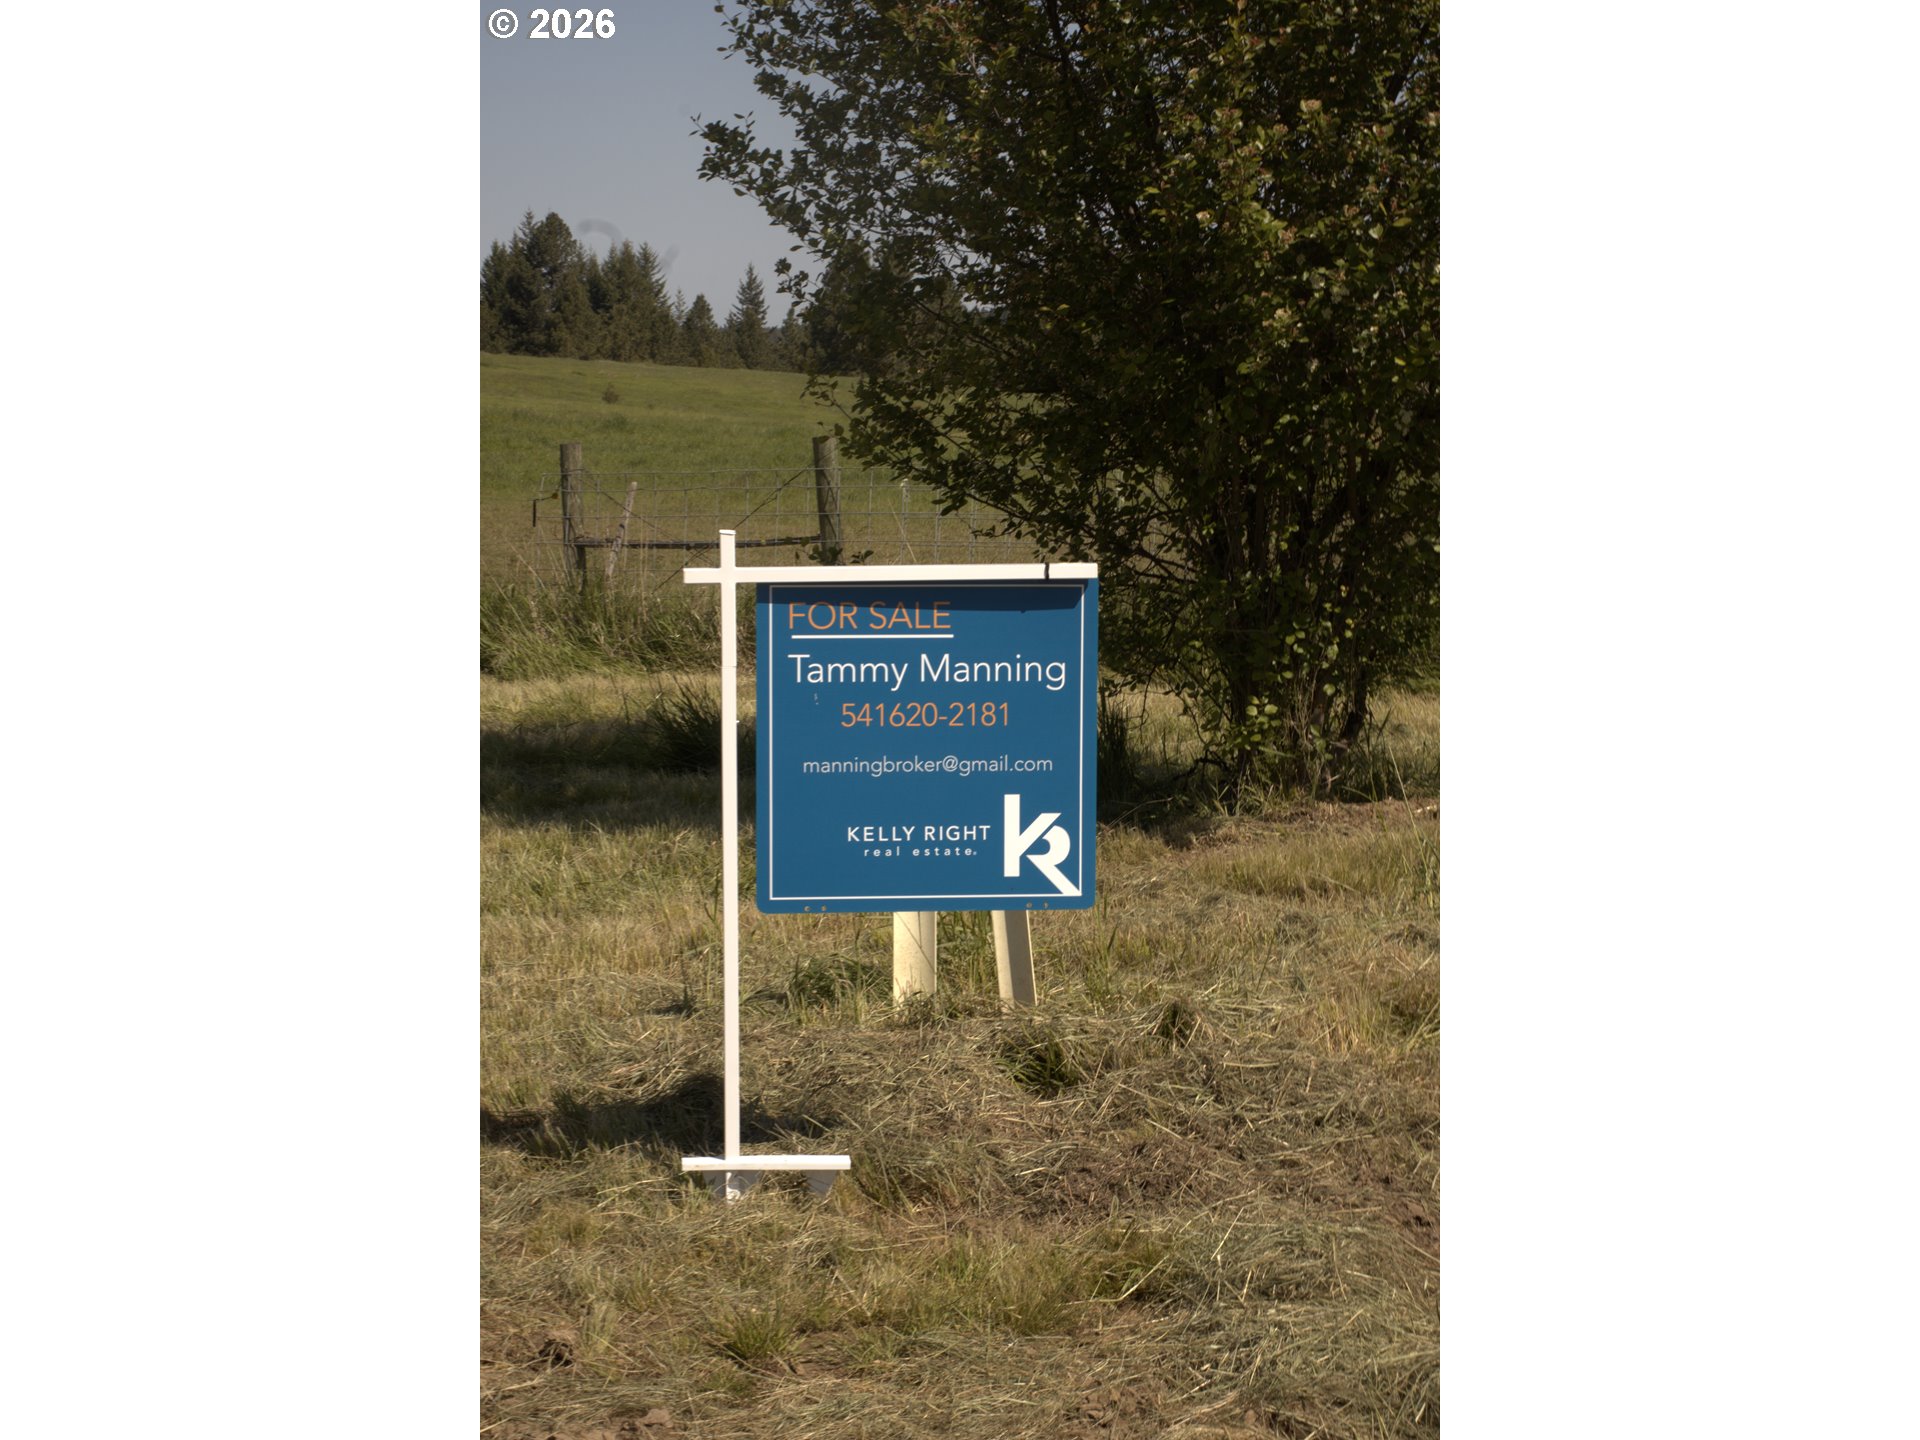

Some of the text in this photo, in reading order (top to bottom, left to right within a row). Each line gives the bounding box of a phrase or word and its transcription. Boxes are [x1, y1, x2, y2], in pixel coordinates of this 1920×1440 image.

[788, 601, 952, 630] FOR SALE
[787, 653, 1066, 691] Tammy Manning
[841, 702, 1009, 728] 541620-2181
[803, 755, 1053, 777] manningbroker@gmail.com
[847, 825, 991, 842] KELLY RIGHT
[864, 846, 900, 857] real
